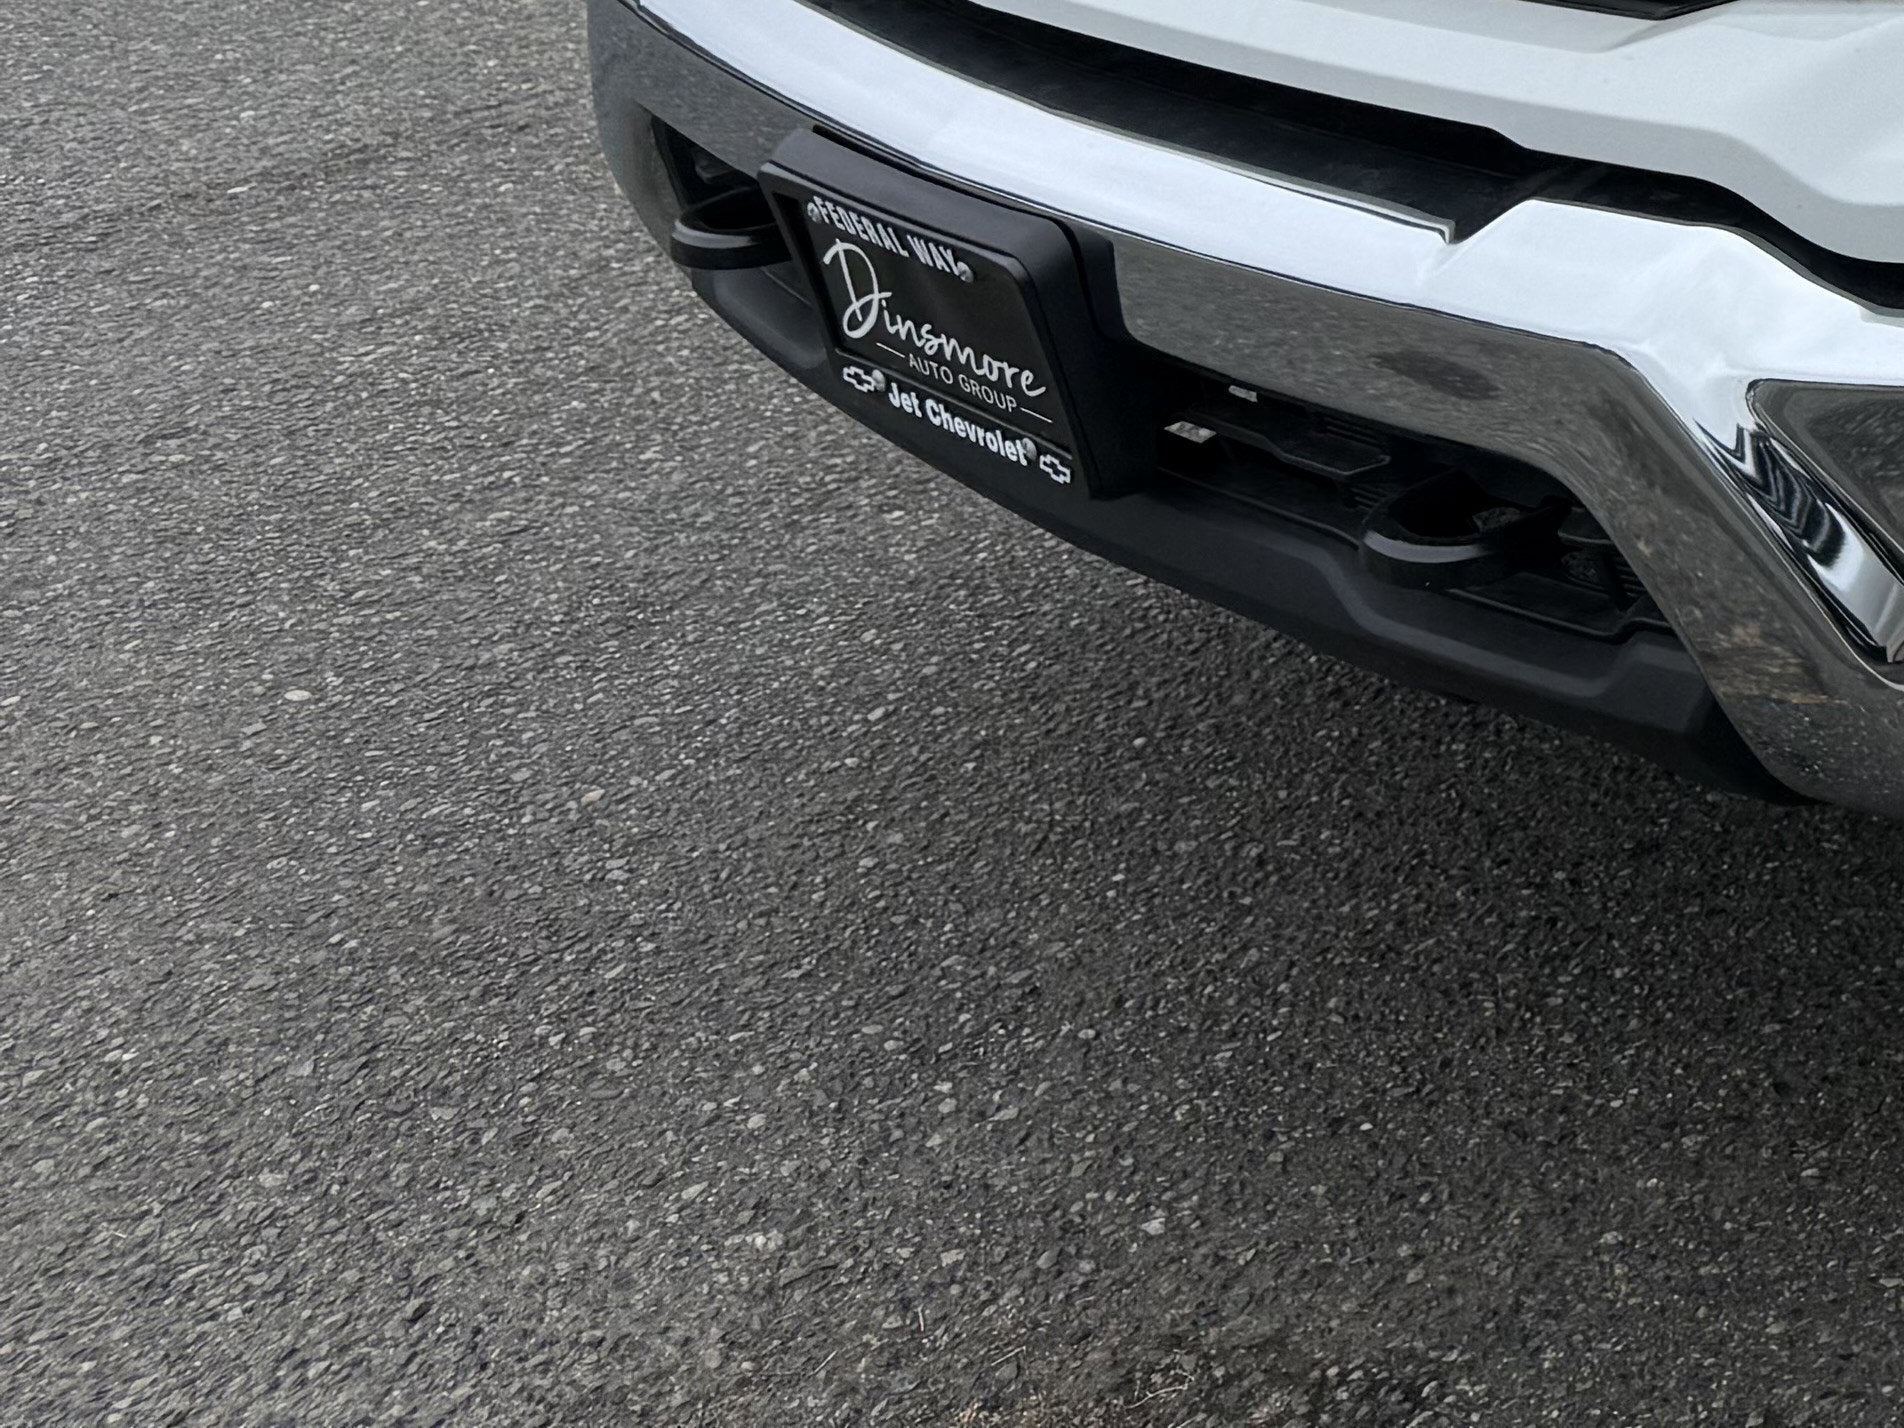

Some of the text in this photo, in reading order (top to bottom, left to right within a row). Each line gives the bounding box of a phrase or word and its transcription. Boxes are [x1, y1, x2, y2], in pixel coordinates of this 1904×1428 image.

[815, 196, 959, 277] FEDERAL WAY
[823, 238, 1046, 398] Dinsmore
[888, 383, 1030, 467] Jet Chevrolet
[909, 354, 1018, 414] AUTO GROUP
